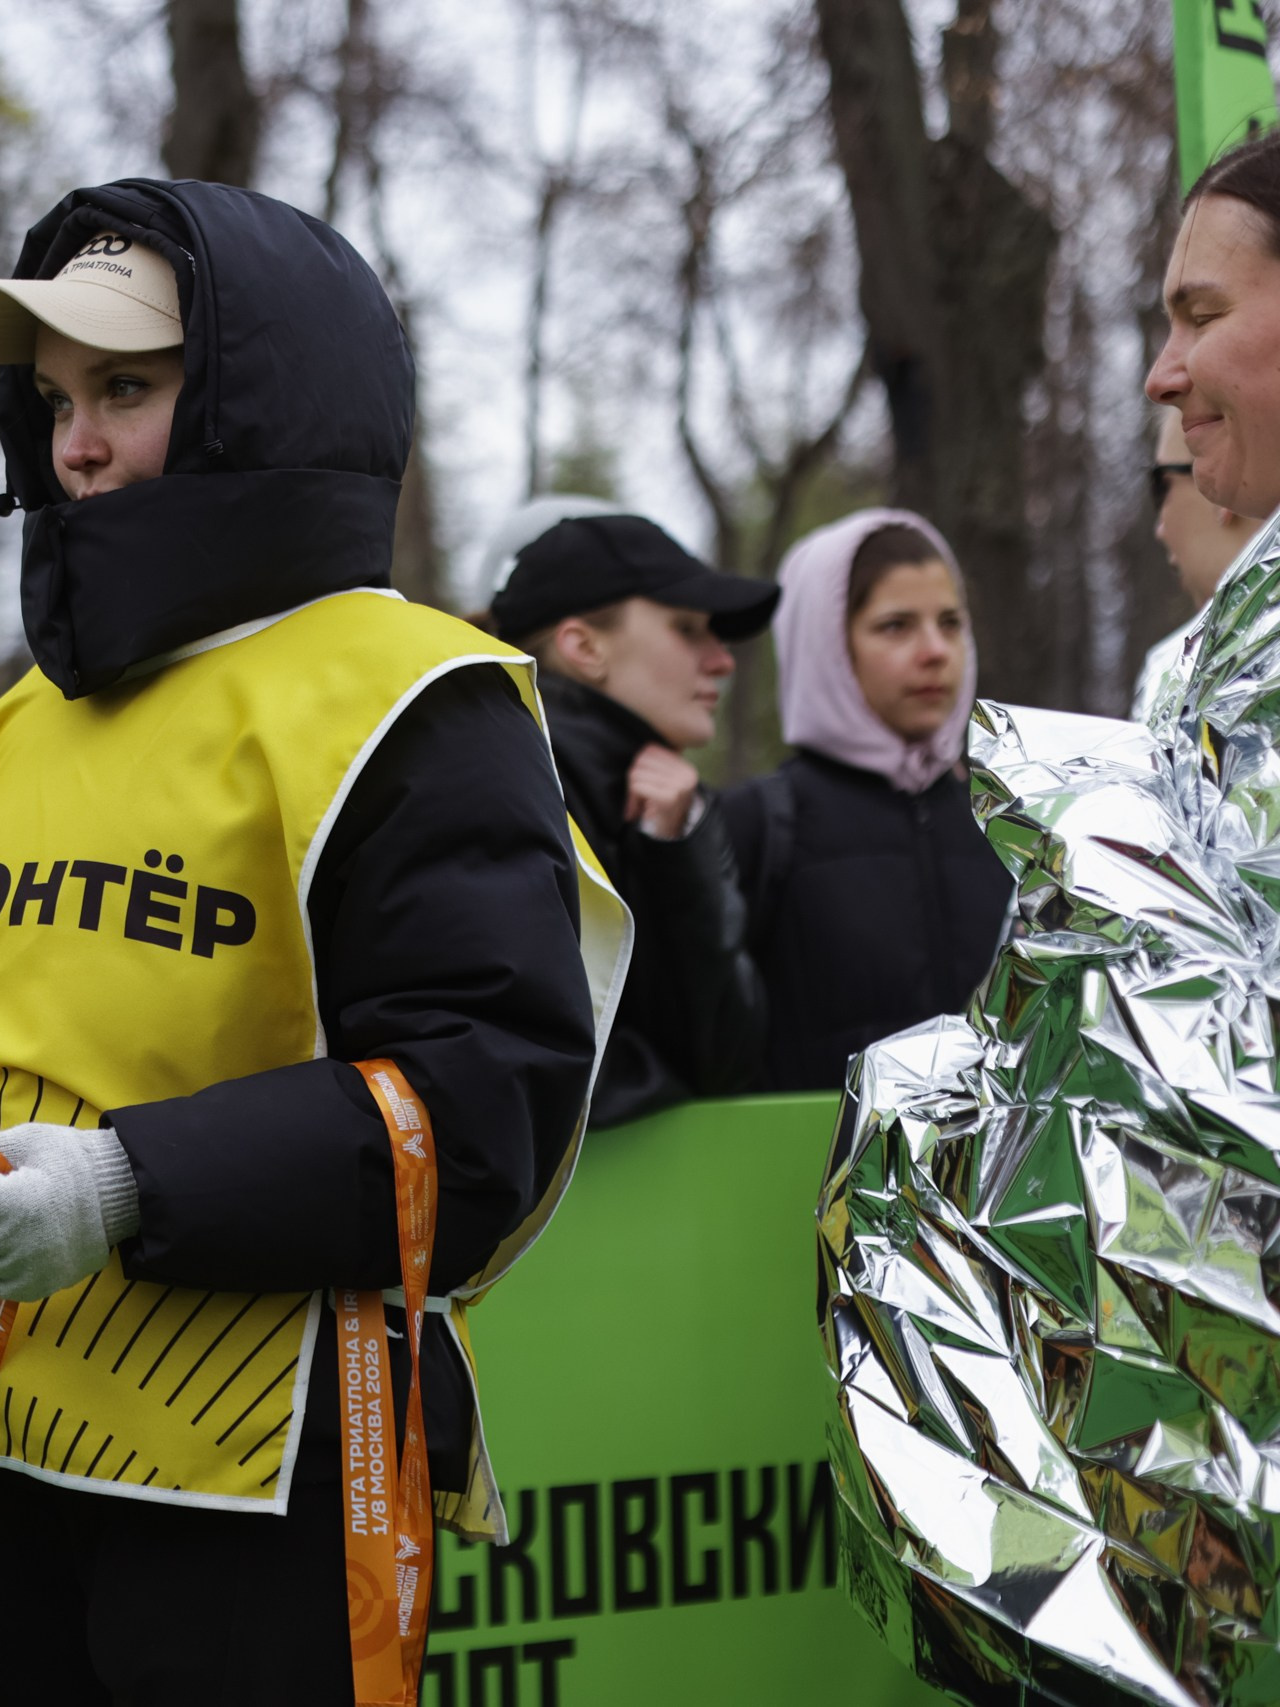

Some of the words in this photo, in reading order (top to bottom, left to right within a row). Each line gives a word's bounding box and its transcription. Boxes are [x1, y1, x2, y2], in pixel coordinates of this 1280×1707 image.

[70, 260, 133, 278] ТРИАТЛОНА
[370, 1071, 410, 1131] МОСКОВСКИЙ
[401, 1098, 422, 1129] СПОРТ
[344, 1289, 358, 1313] IR
[345, 1317, 360, 1332] &
[364, 1339, 381, 1394] 2026
[346, 1338, 365, 1472] ТРИАТЛОНА
[367, 1398, 385, 1494] МОСКВА
[351, 1476, 368, 1536] ЛИГА
[371, 1500, 389, 1536] 1/8
[398, 1565, 419, 1636] МОСКОВСКИЙ
